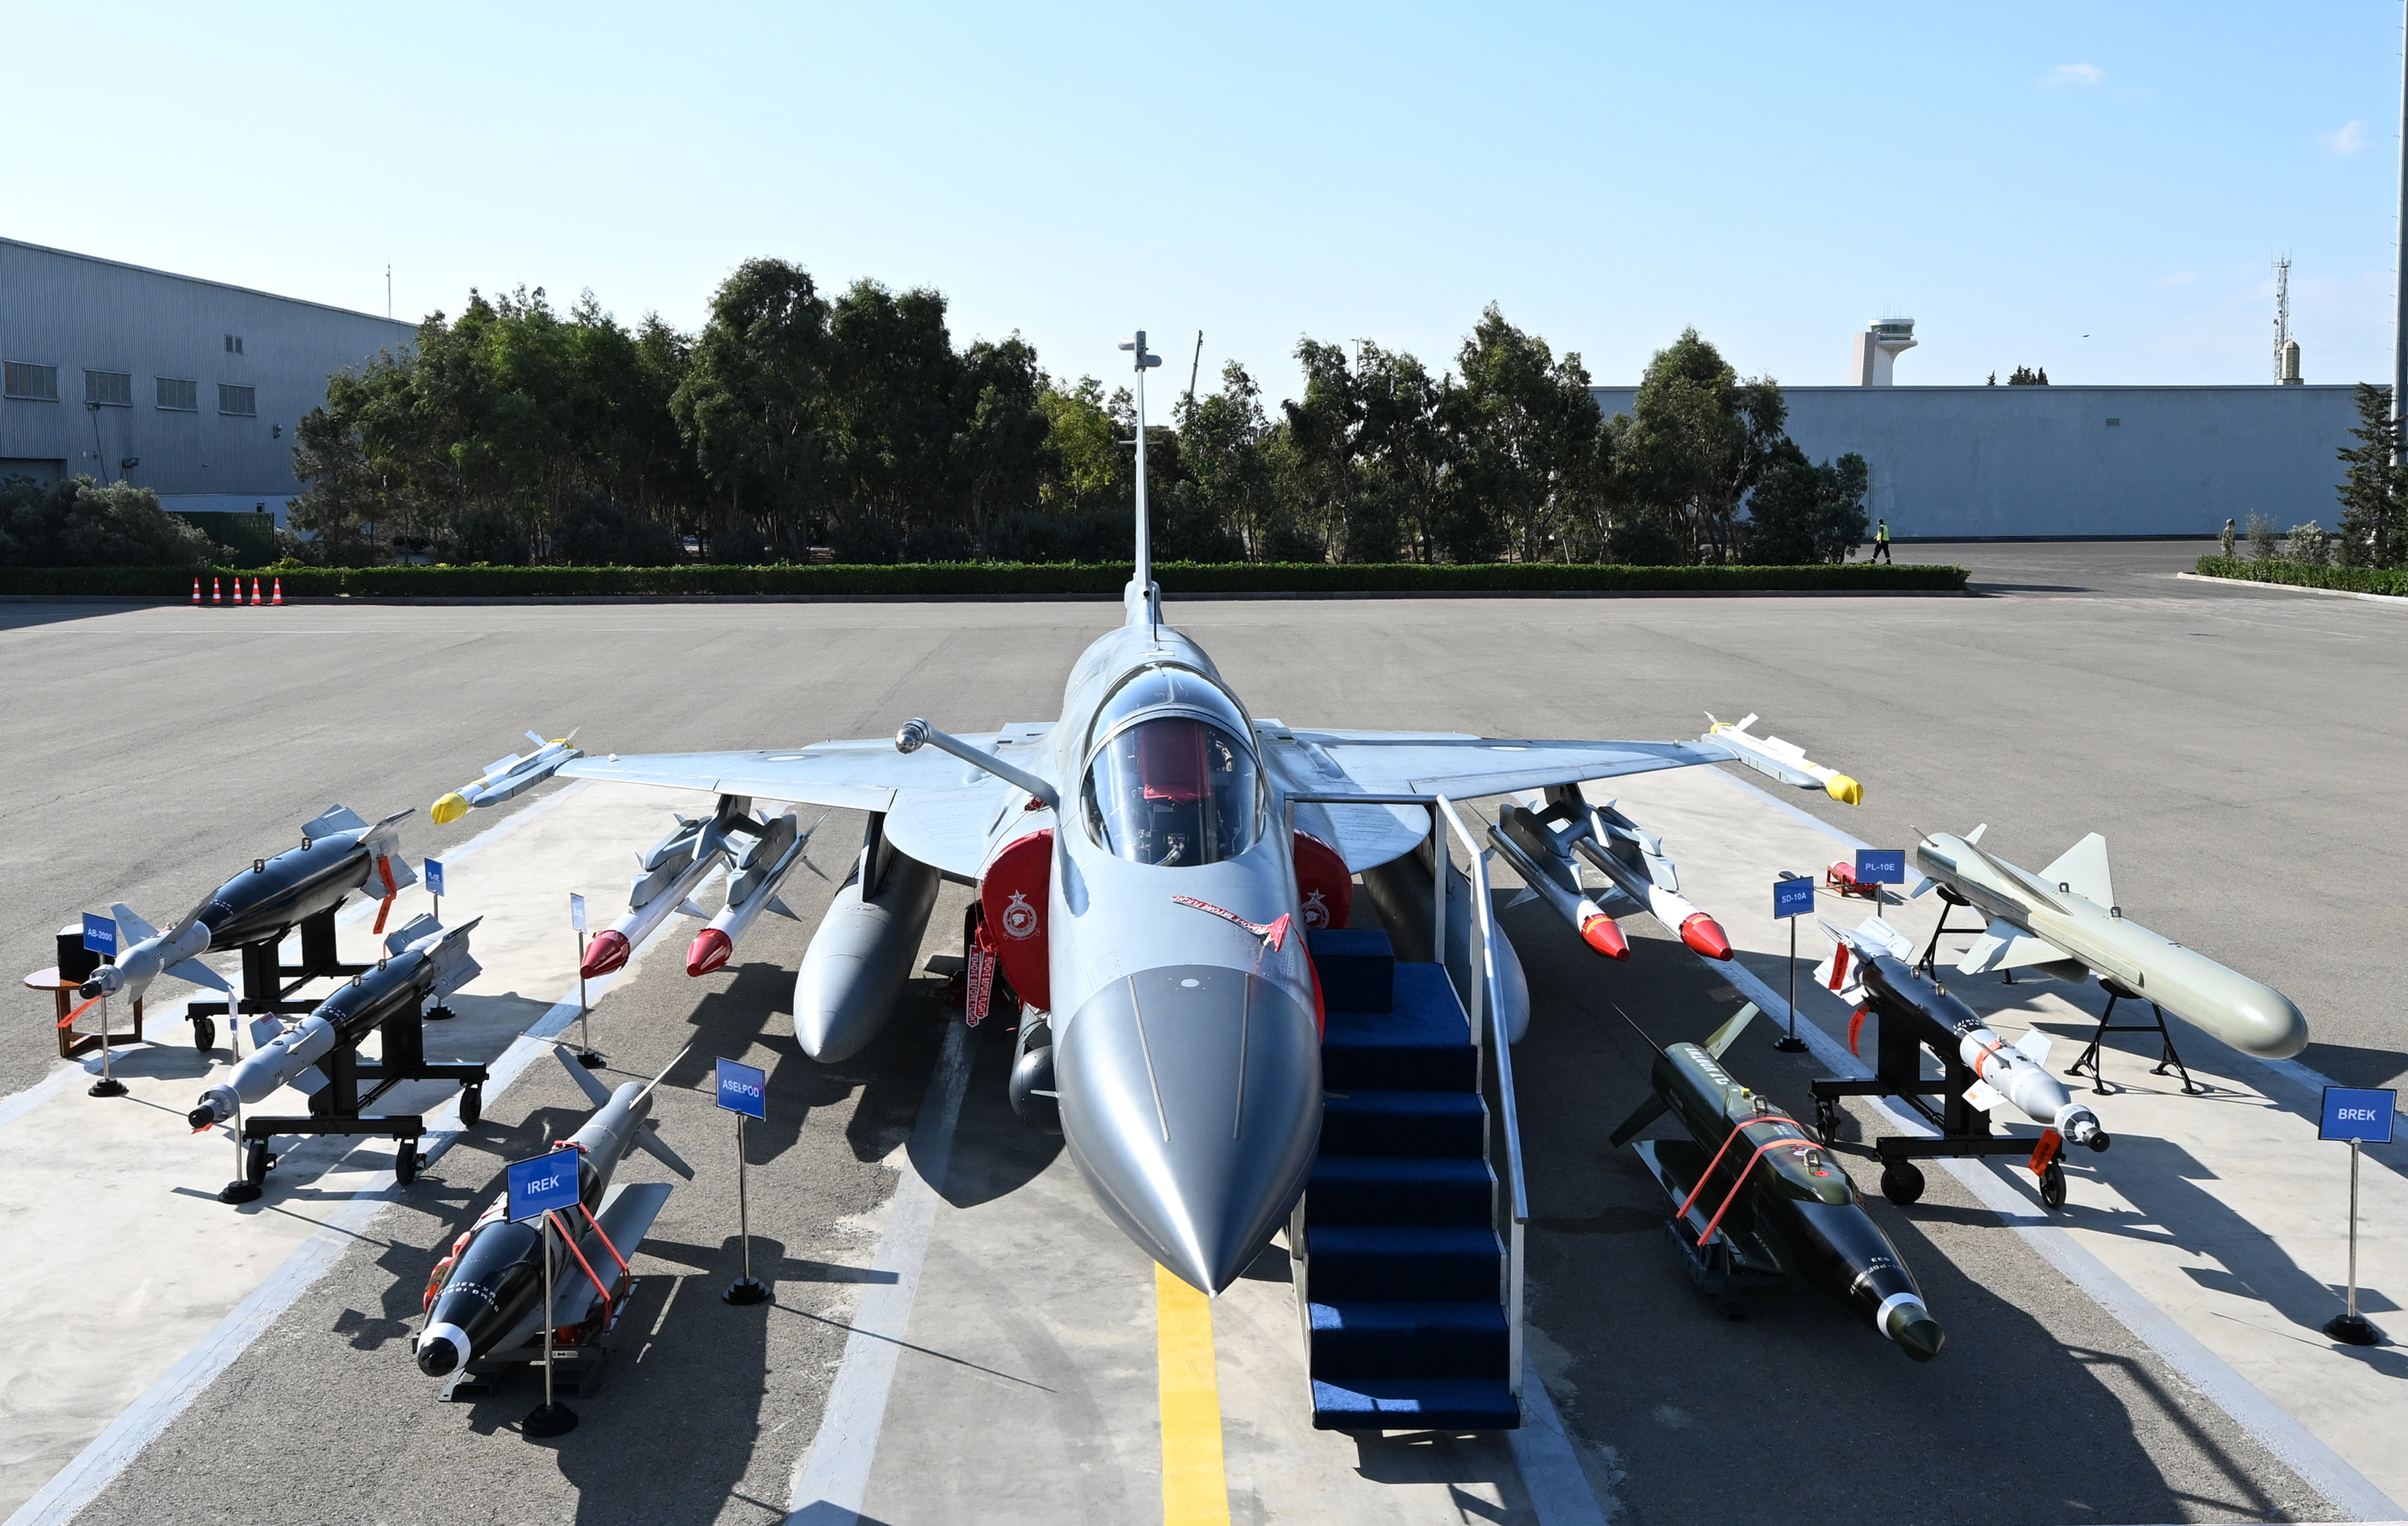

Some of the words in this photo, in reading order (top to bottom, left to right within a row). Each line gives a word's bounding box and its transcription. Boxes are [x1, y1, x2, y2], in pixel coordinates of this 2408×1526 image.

[1865, 863, 1896, 871] PL-10E
[1781, 891, 1807, 904] SD-10A
[88, 927, 113, 942] AB-2000
[971, 952, 979, 978] REMOVE
[982, 956, 993, 977] REMOVE
[969, 978, 977, 1002] BEFORE
[979, 978, 990, 997] BEFORE
[969, 1004, 977, 1025] FLIGHT
[977, 997, 987, 1015] FLIGHT
[2338, 1108, 2376, 1121] BREK
[527, 1175, 559, 1194] IREK
[472, 1289, 500, 1313] BOMB
